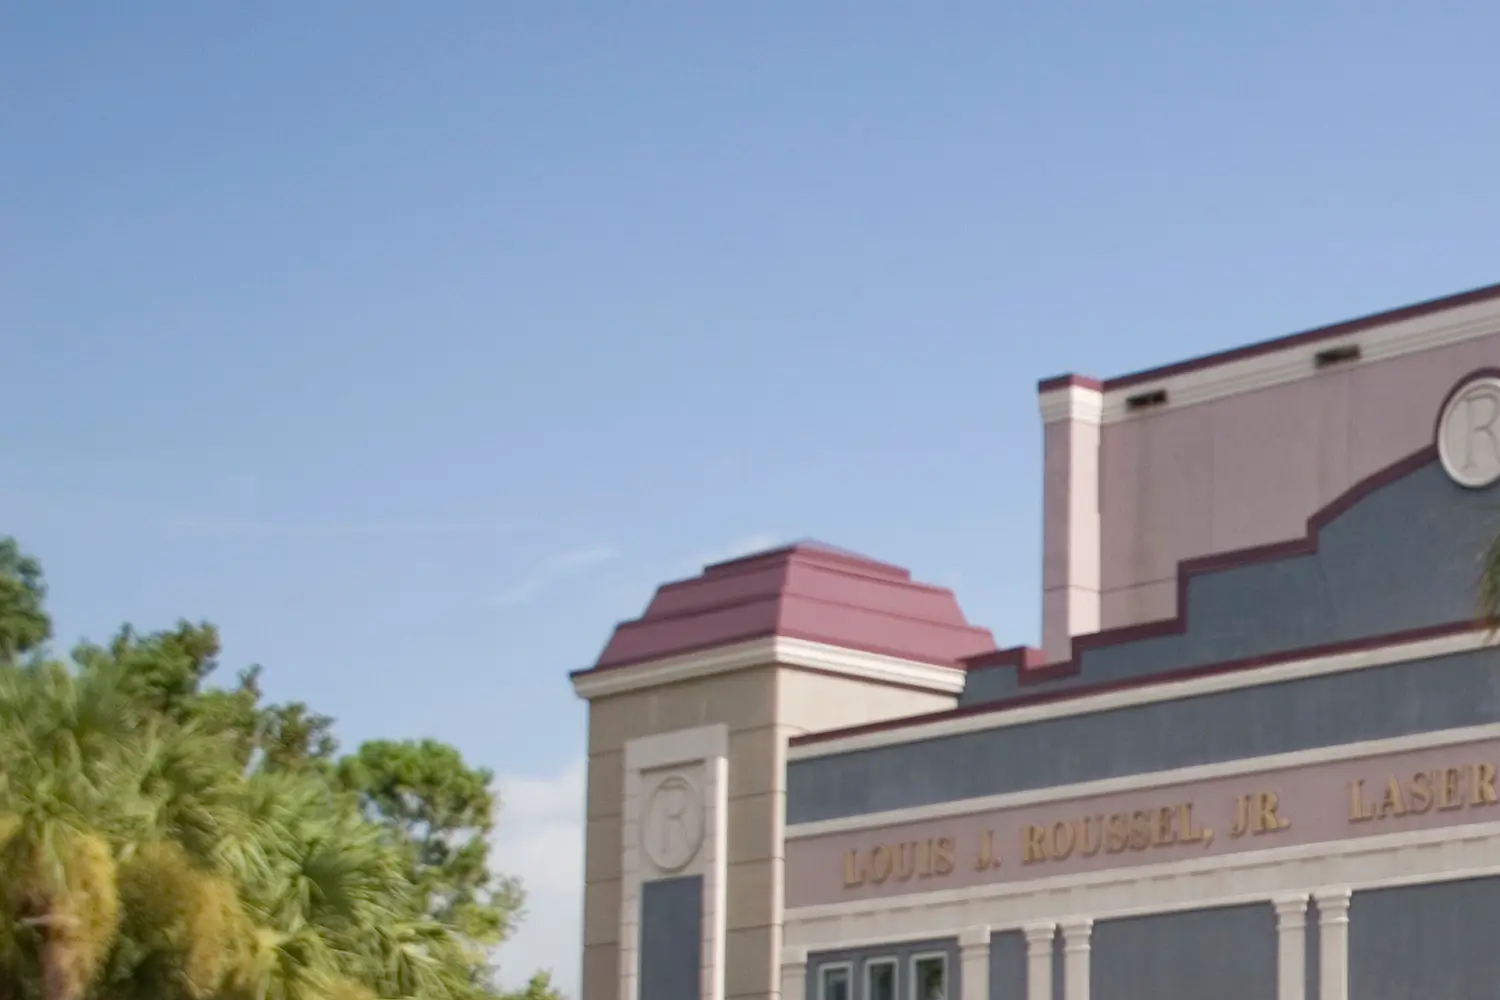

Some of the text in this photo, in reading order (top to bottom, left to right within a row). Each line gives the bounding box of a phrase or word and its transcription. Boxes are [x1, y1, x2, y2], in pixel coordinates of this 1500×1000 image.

[843, 836, 956, 889] LOUIS
[974, 829, 1001, 873] J.
[1020, 802, 1215, 866] ROUSSEL,
[1229, 791, 1291, 839] JR.
[1347, 761, 1499, 823] LASER
